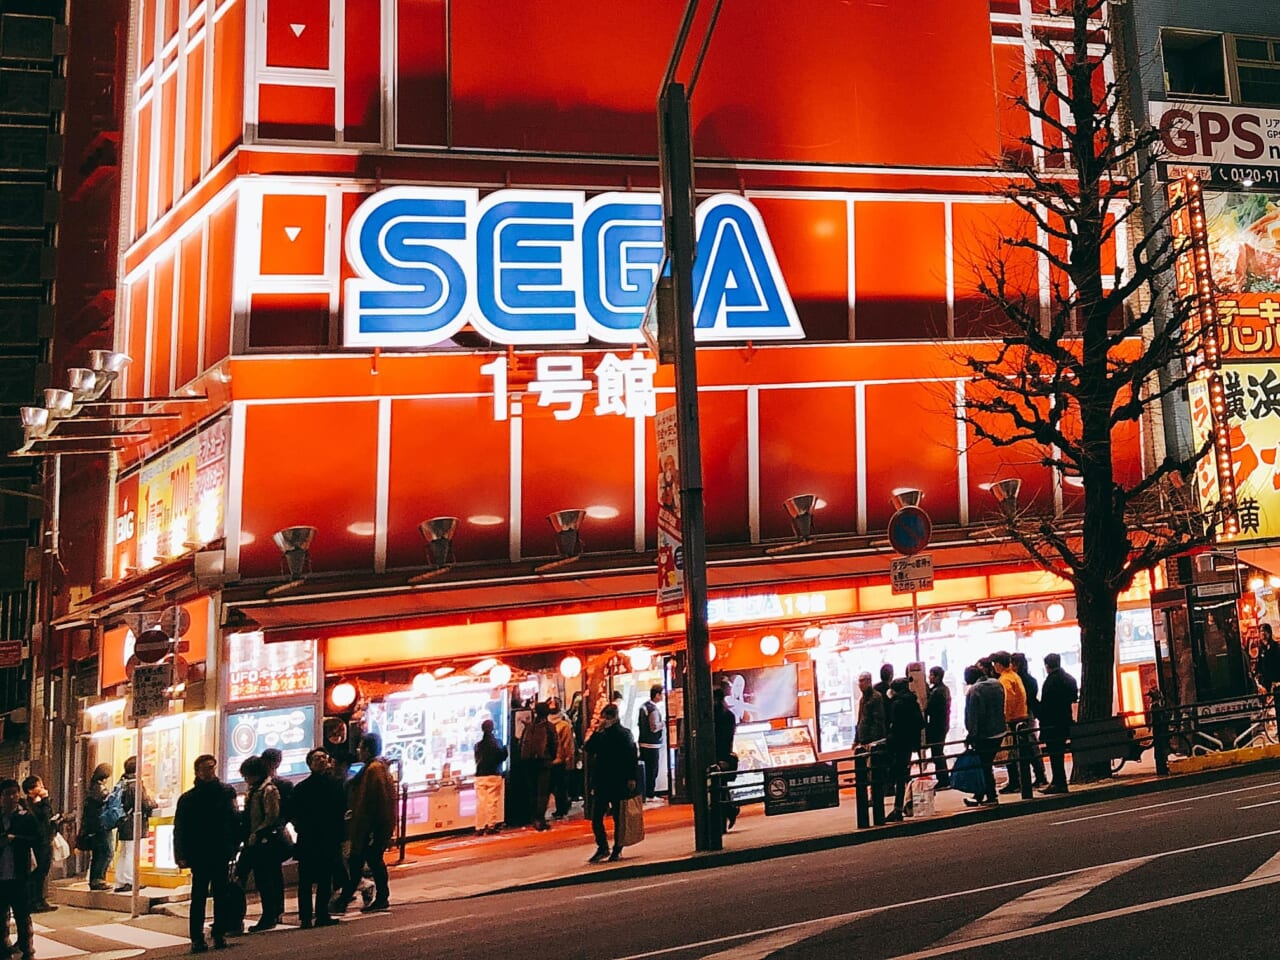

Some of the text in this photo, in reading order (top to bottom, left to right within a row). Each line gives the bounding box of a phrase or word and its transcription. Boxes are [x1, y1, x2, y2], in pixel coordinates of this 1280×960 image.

[1159, 109, 1264, 159] GPS
[343, 186, 806, 348] SEGA
[480, 352, 657, 424] 1号館
[116, 510, 135, 545] BIG
